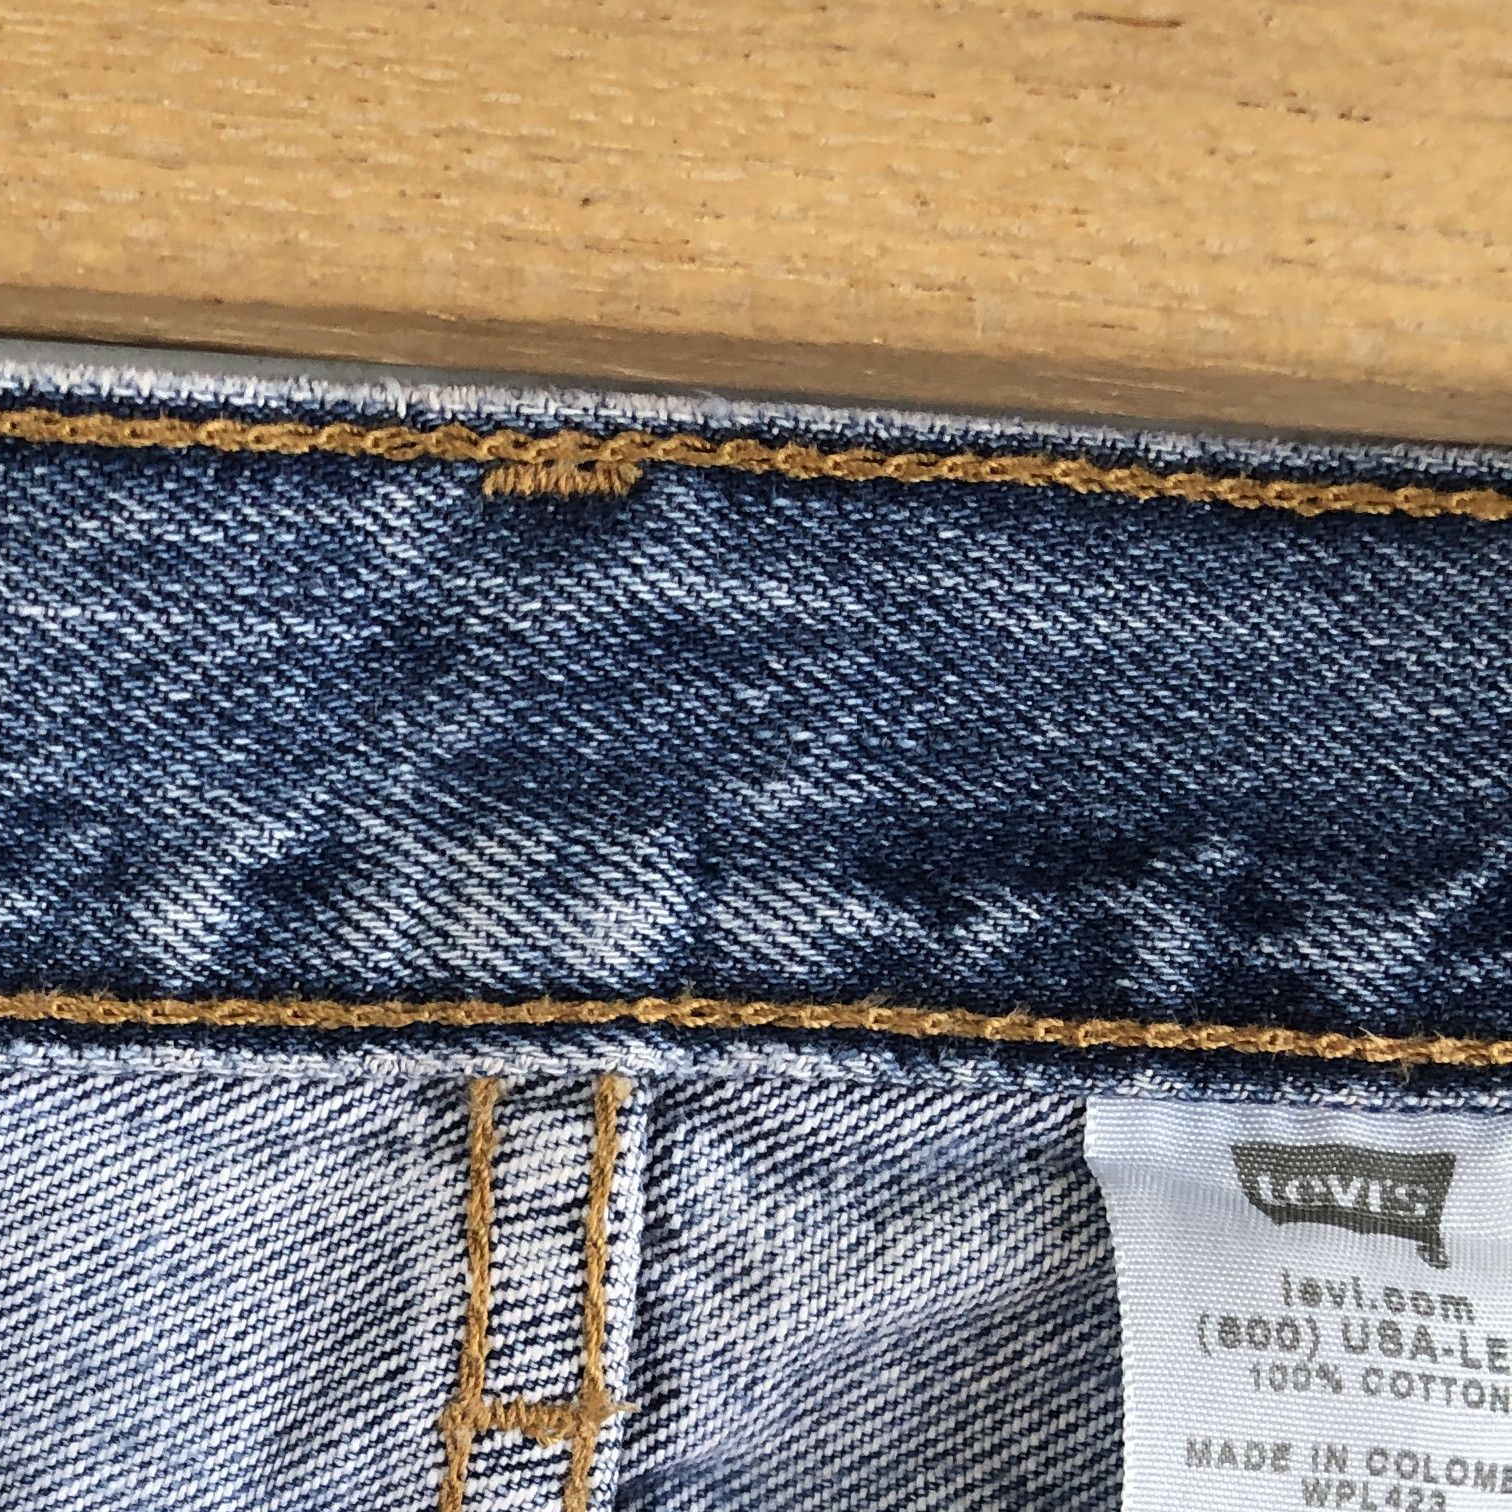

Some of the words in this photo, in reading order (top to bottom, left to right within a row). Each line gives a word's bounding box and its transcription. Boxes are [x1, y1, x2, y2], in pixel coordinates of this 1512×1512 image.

[1198, 1313, 1319, 1361] (800)
[1251, 1362, 1343, 1394] 100%
[1362, 1366, 1511, 1414] COTTON
[1186, 1439, 1291, 1473] MADE
[1311, 1443, 1348, 1474] IN
